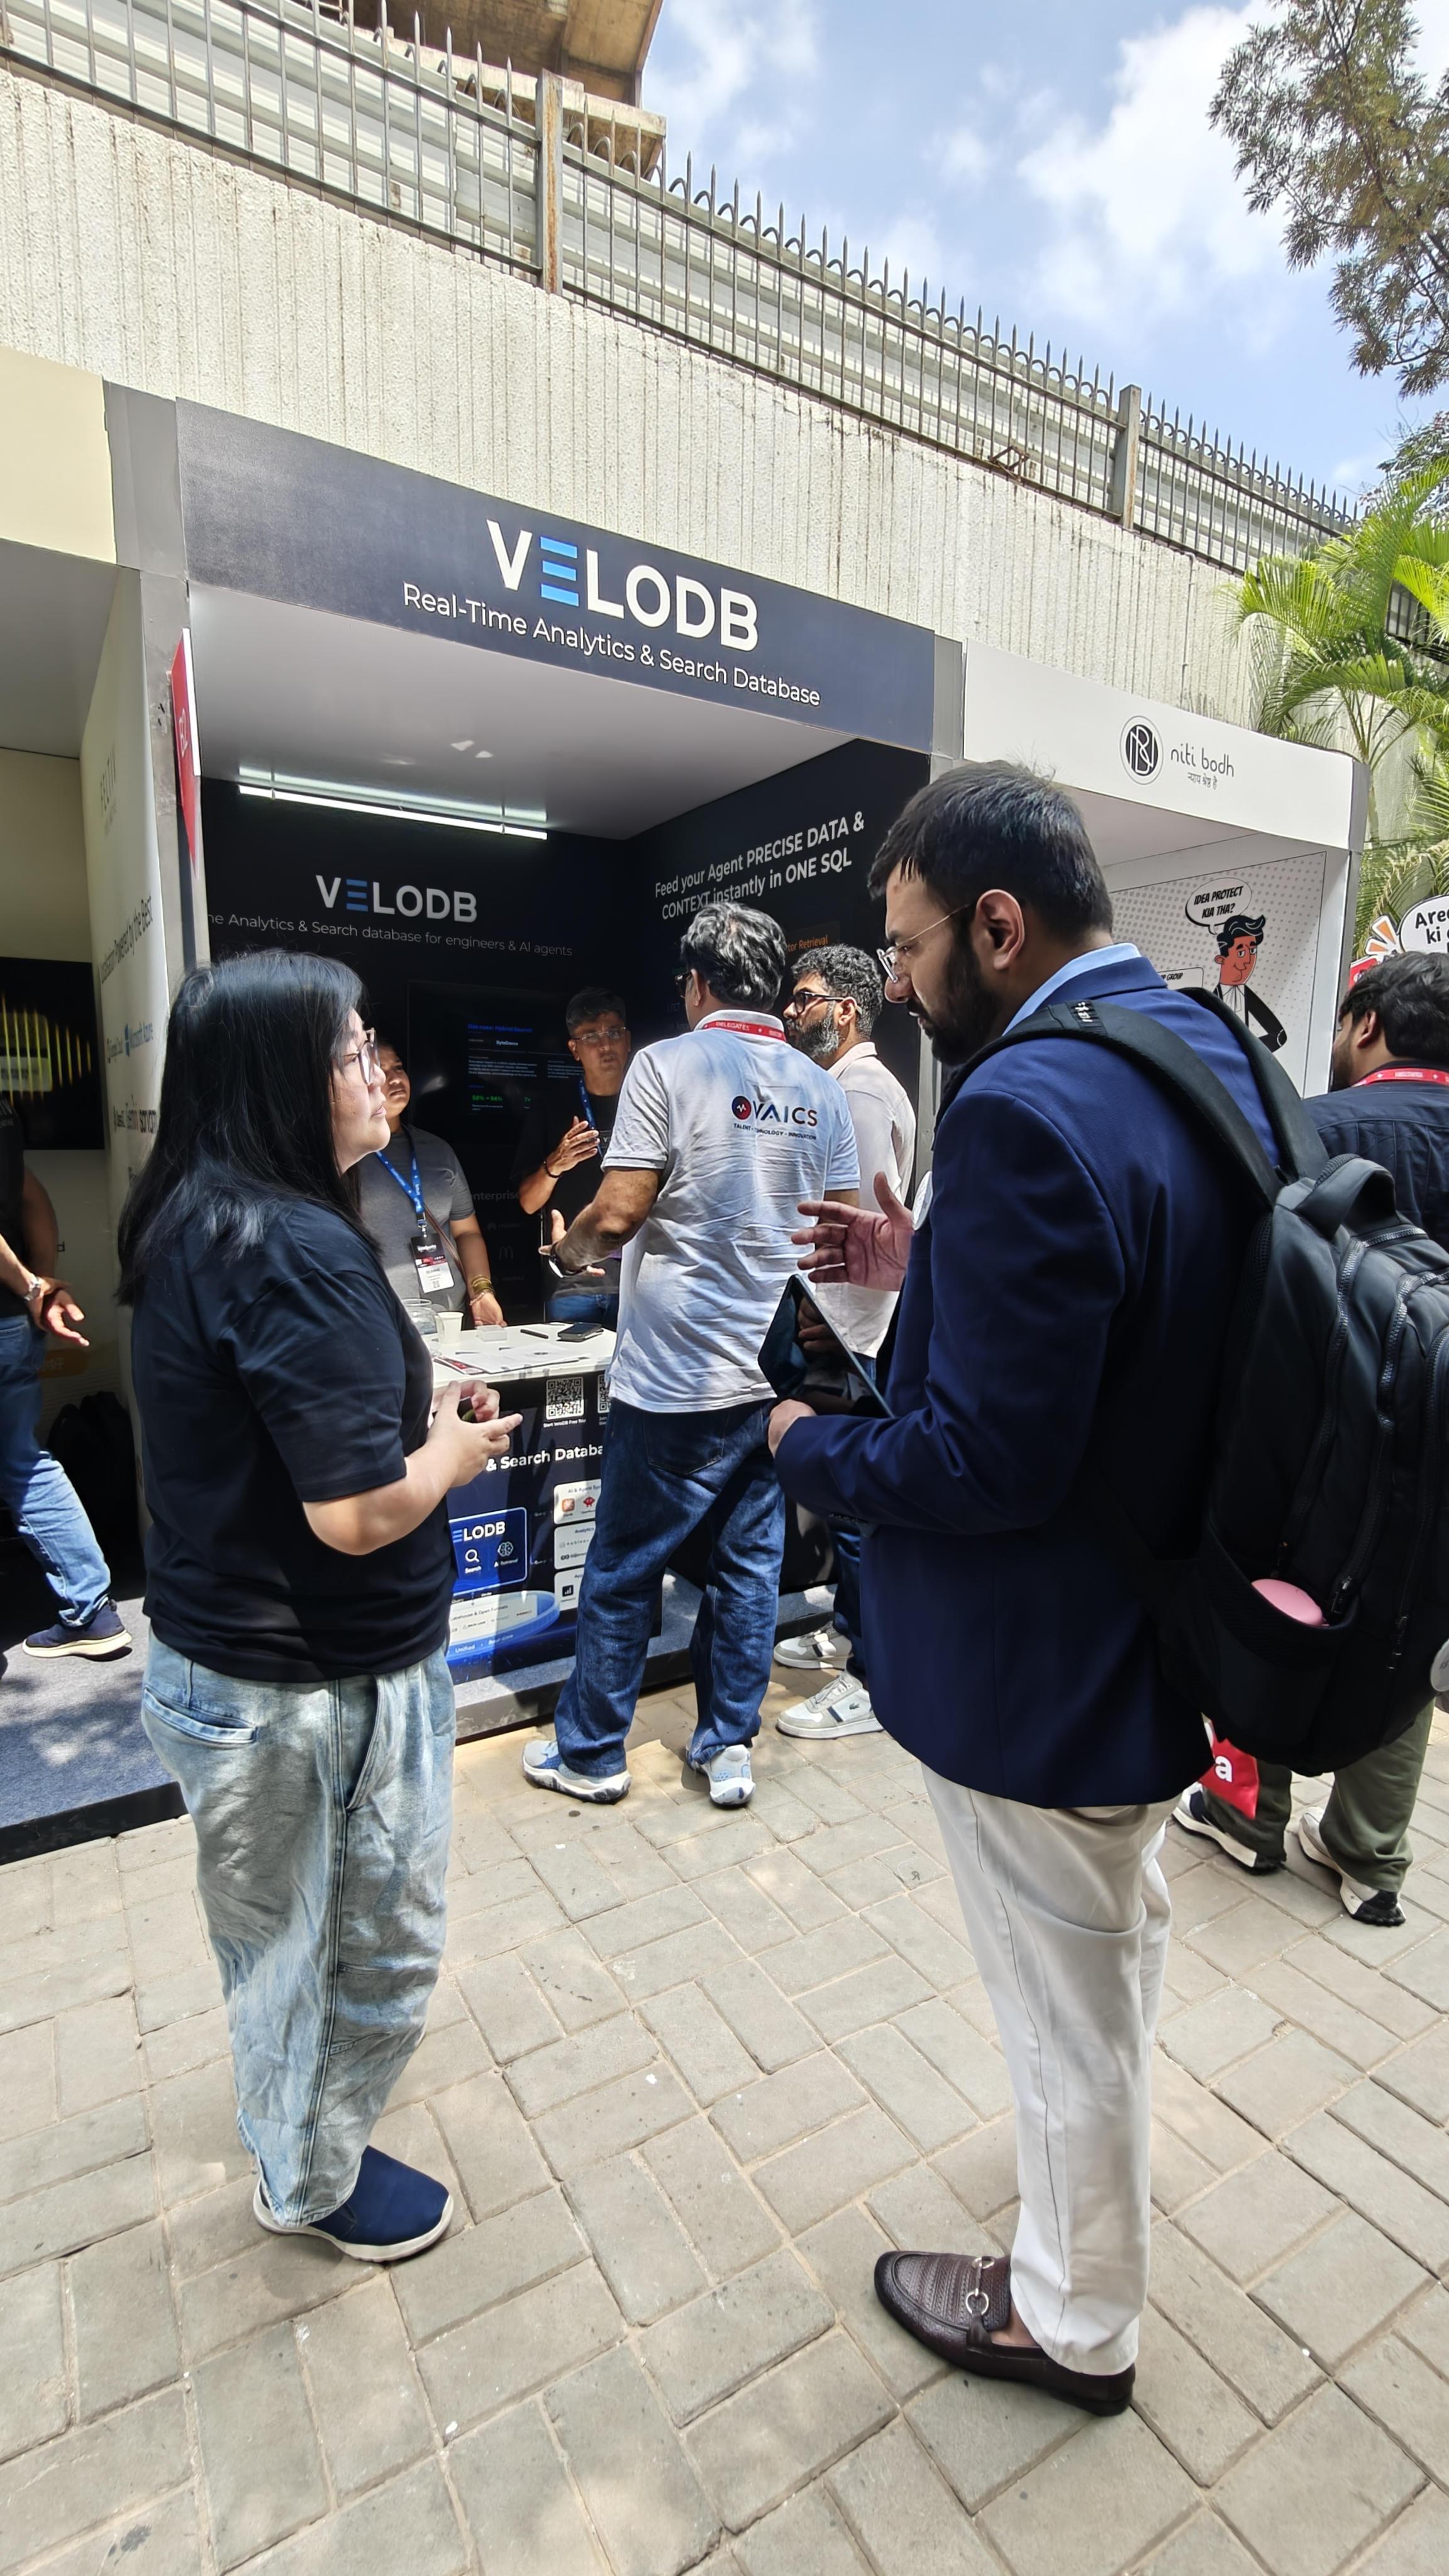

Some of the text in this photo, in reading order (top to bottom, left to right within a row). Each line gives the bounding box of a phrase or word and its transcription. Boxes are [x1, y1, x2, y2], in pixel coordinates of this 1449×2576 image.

[486, 519, 759, 652] VELODB
[402, 581, 821, 706] Real-Time Analytics & Search Database
[1170, 743, 1196, 767] niti
[1201, 747, 1235, 777] bodh
[655, 811, 865, 898] Feed your Agent PRECISE DATA &
[662, 847, 852, 920] CONTEXT instantly in ONE SQL
[315, 874, 477, 923] VELODB
[1194, 886, 1244, 905] IDEA PROTECT
[1202, 903, 1235, 919] KIA THA?
[1415, 909, 1449, 929] Are
[228, 914, 294, 932] Analytics
[299, 920, 308, 932] &
[312, 921, 358, 938] Search
[362, 926, 422, 943] database
[425, 933, 442, 944] for
[446, 936, 505, 951] engineers
[508, 940, 516, 951] &
[519, 941, 531, 952] AI
[534, 945, 572, 957] agents
[799, 935, 828, 950] Retrieval
[1426, 926, 1441, 945] ki
[716, 1021, 750, 1031] DELEGATES
[486, 1459, 497, 1472] &
[501, 1450, 551, 1470] Search
[455, 1643, 475, 1654] Unified
